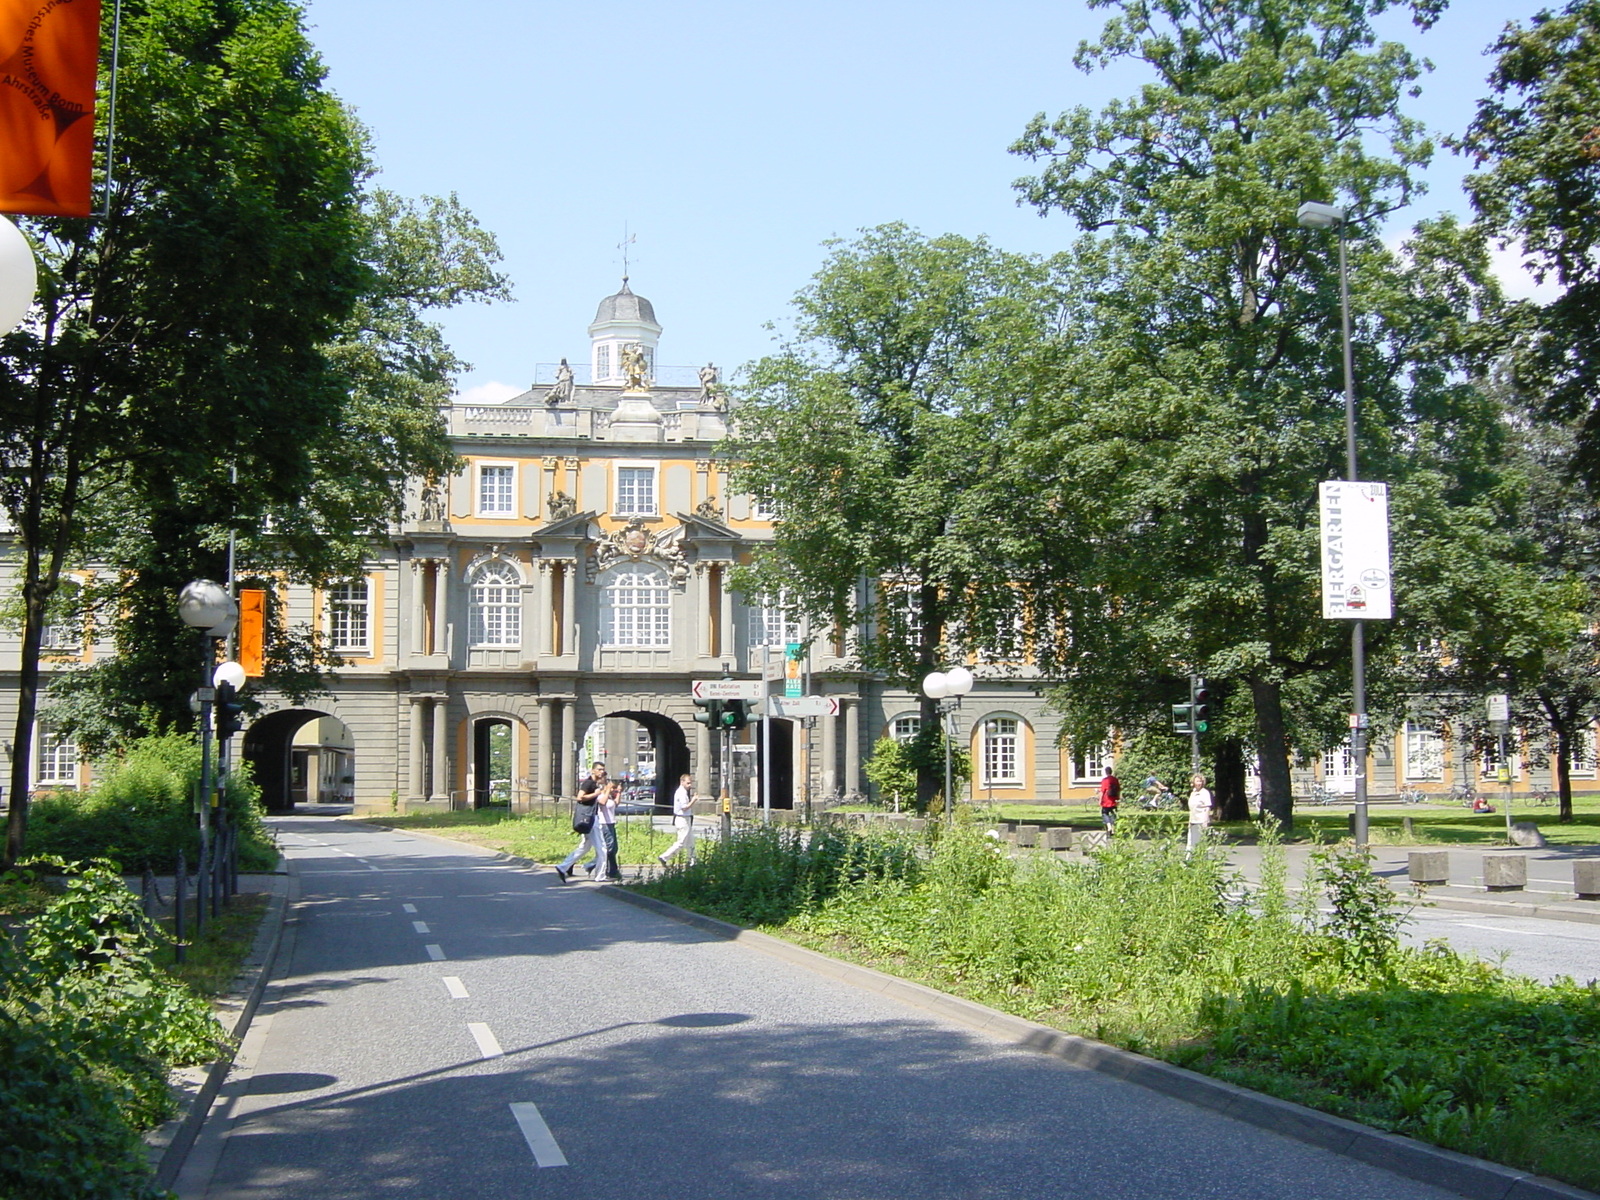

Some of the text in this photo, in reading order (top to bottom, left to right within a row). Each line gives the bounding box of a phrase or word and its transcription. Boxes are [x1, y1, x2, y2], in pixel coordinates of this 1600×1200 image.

[2, 75, 50, 121] Ahrstraße
[22, 46, 50, 97] Museum
[50, 92, 84, 113] Bonn
[1326, 485, 1345, 613] BIERGARTEN
